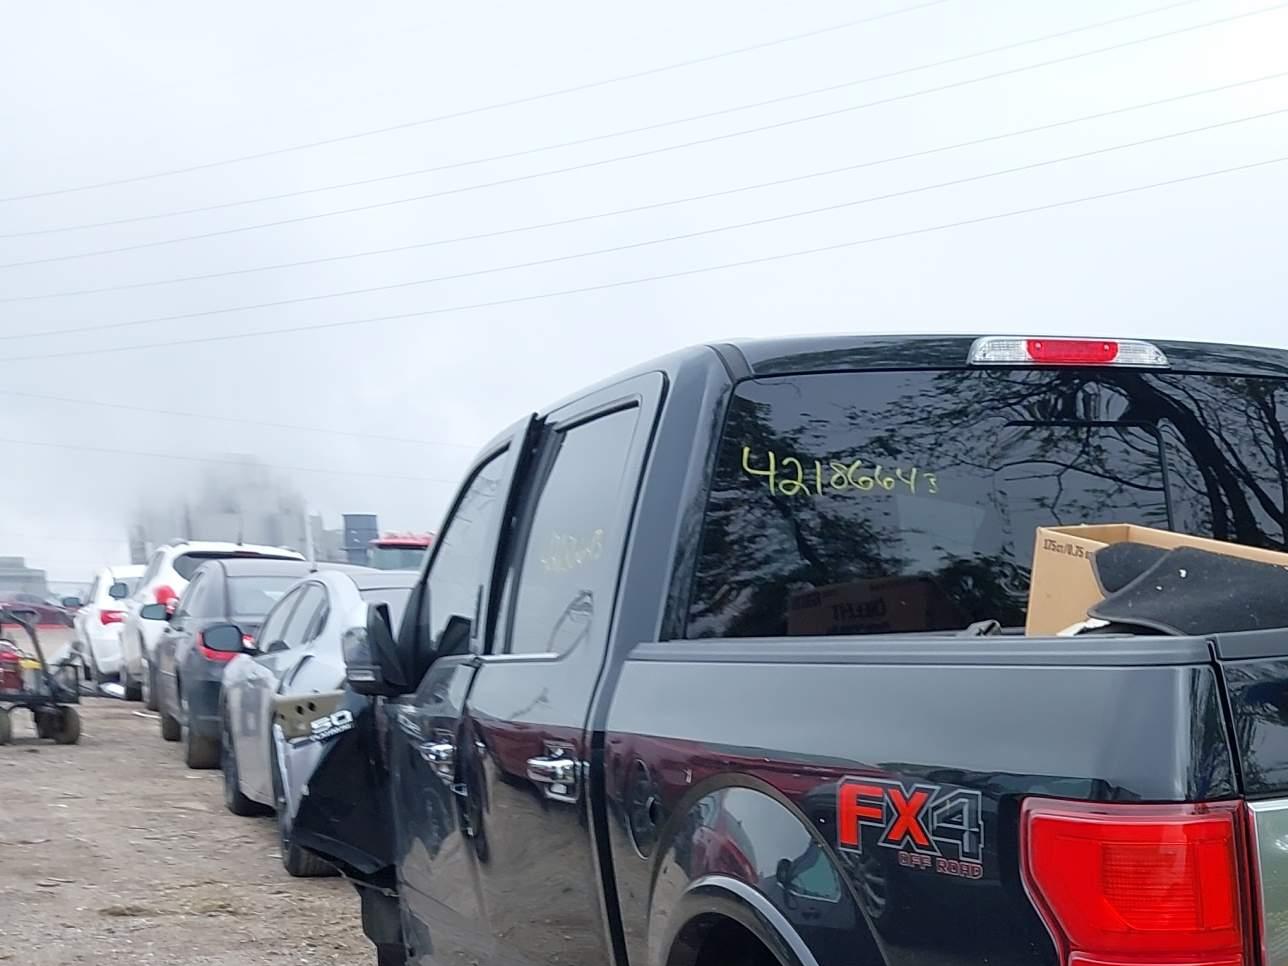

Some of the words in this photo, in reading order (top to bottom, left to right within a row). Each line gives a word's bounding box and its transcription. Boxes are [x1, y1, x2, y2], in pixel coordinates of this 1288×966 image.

[742, 446, 938, 496] 42186643
[837, 775, 985, 864] FX4
[899, 851, 934, 870] OFF
[935, 858, 984, 880] ROAD
